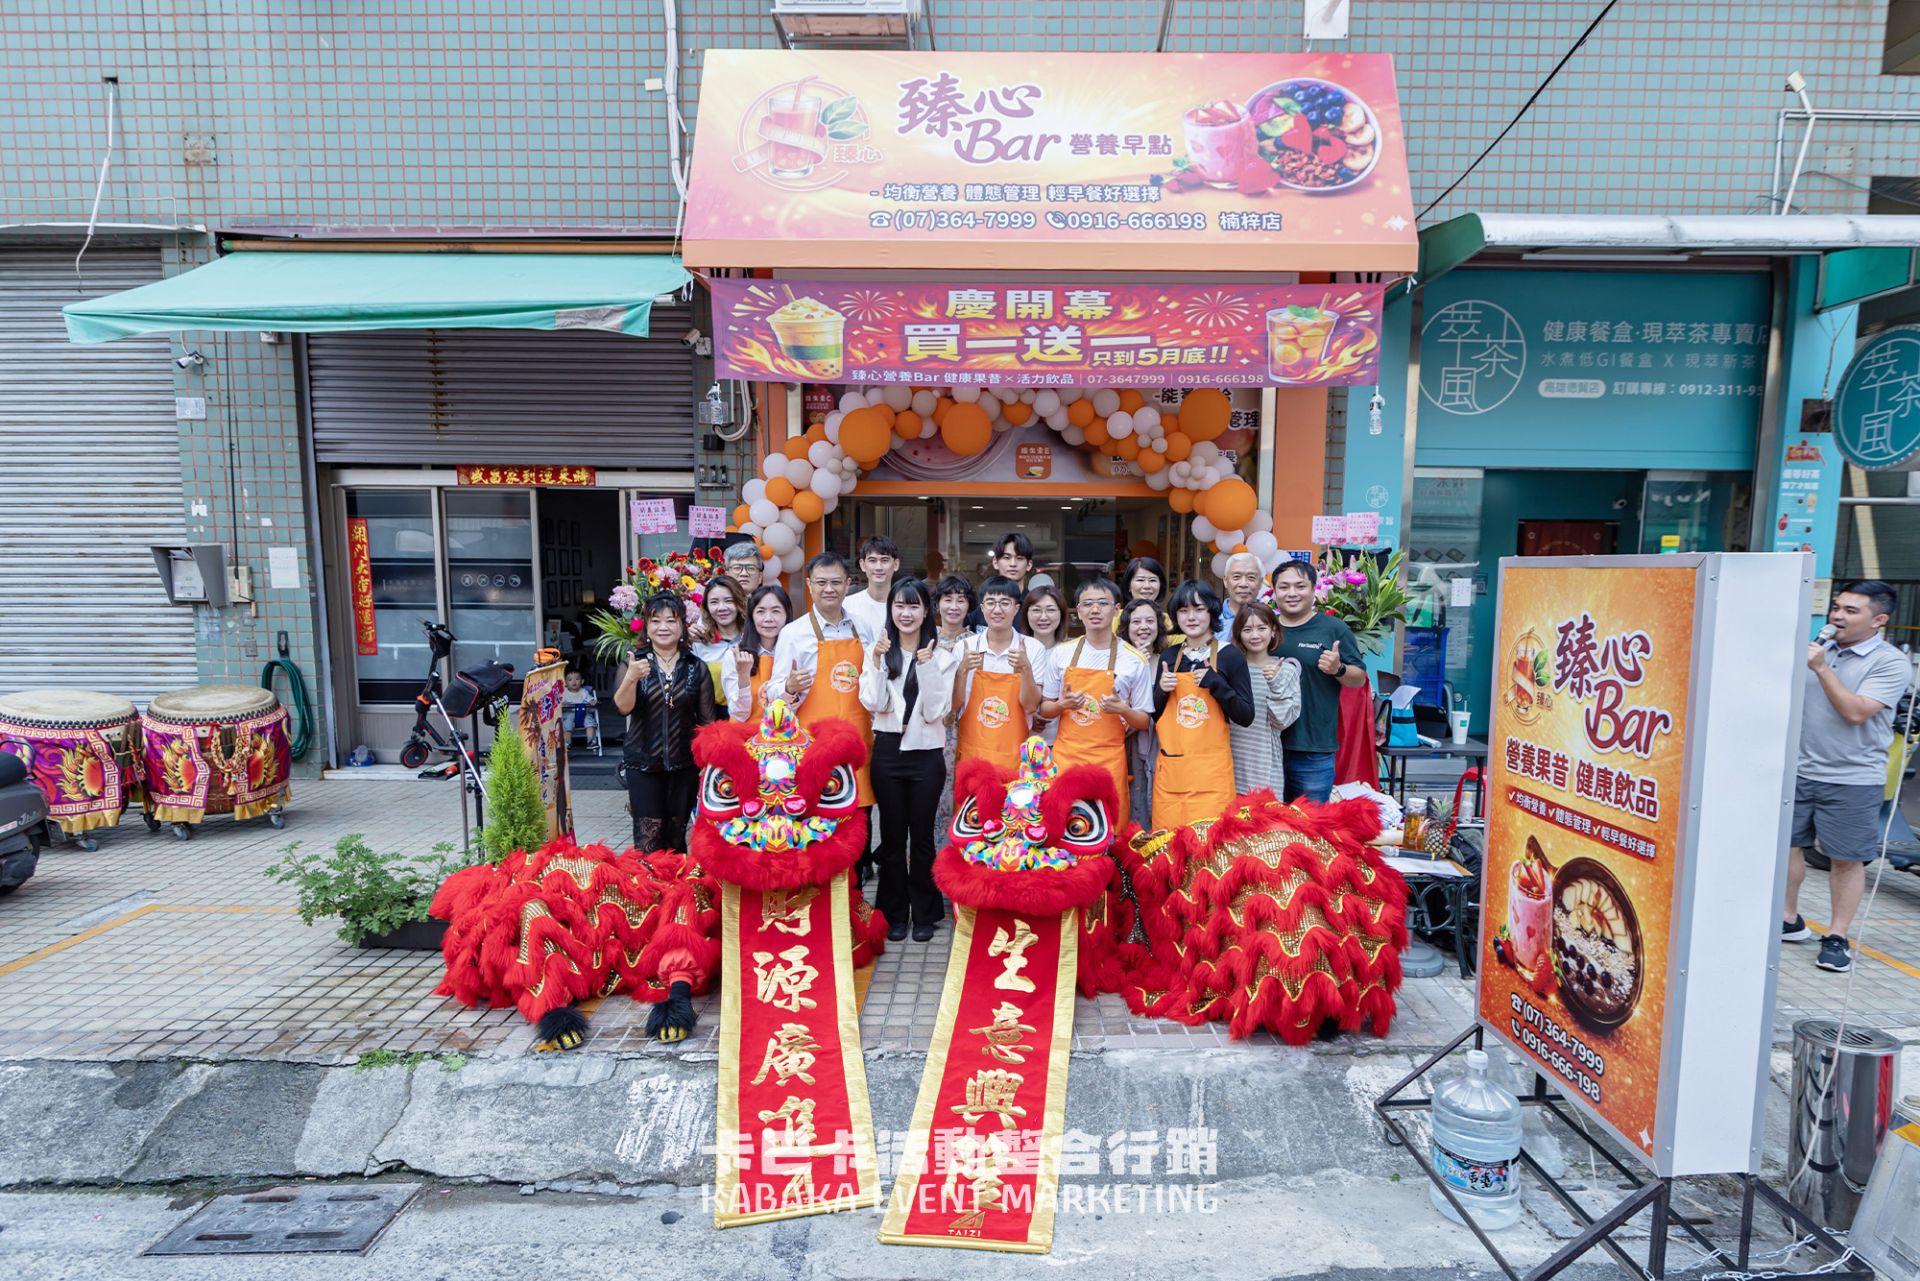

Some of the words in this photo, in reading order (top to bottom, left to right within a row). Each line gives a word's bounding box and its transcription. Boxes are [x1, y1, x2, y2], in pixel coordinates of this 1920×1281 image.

[897, 72, 1042, 137] 臻心
[833, 144, 882, 163] 臻心
[955, 118, 1061, 165] Bar
[1069, 133, 1172, 155] 營養早點
[884, 184, 957, 201] 均衡營養
[965, 184, 1041, 201] 體態管理
[1046, 184, 1161, 202] 輕早餐好選擇
[895, 211, 1036, 231] (07)364-7999
[1067, 212, 1206, 230] 0916-666198
[1219, 212, 1281, 231] 楠梓店
[945, 289, 1112, 320] 慶開幕
[904, 323, 1150, 362] 買一送一
[1685, 354, 1765, 369] 現萃新茶
[944, 371, 1000, 384] 健康果昔
[1017, 372, 1074, 385] 活力飲品
[1087, 374, 1165, 384] 07-3647999
[1178, 373, 1264, 384] 0916-666198
[1554, 613, 1651, 699] 臻心
[1585, 679, 1671, 757] Bar
[1506, 737, 1568, 788] 營養果昔
[1576, 759, 1658, 818] 健康飲品
[1516, 792, 1547, 817] 均衡營養
[1601, 826, 1656, 859] 輕早餐好選擇
[1522, 1028, 1601, 1102] 0916-666-198
[947, 1229, 981, 1238] TAIZI
